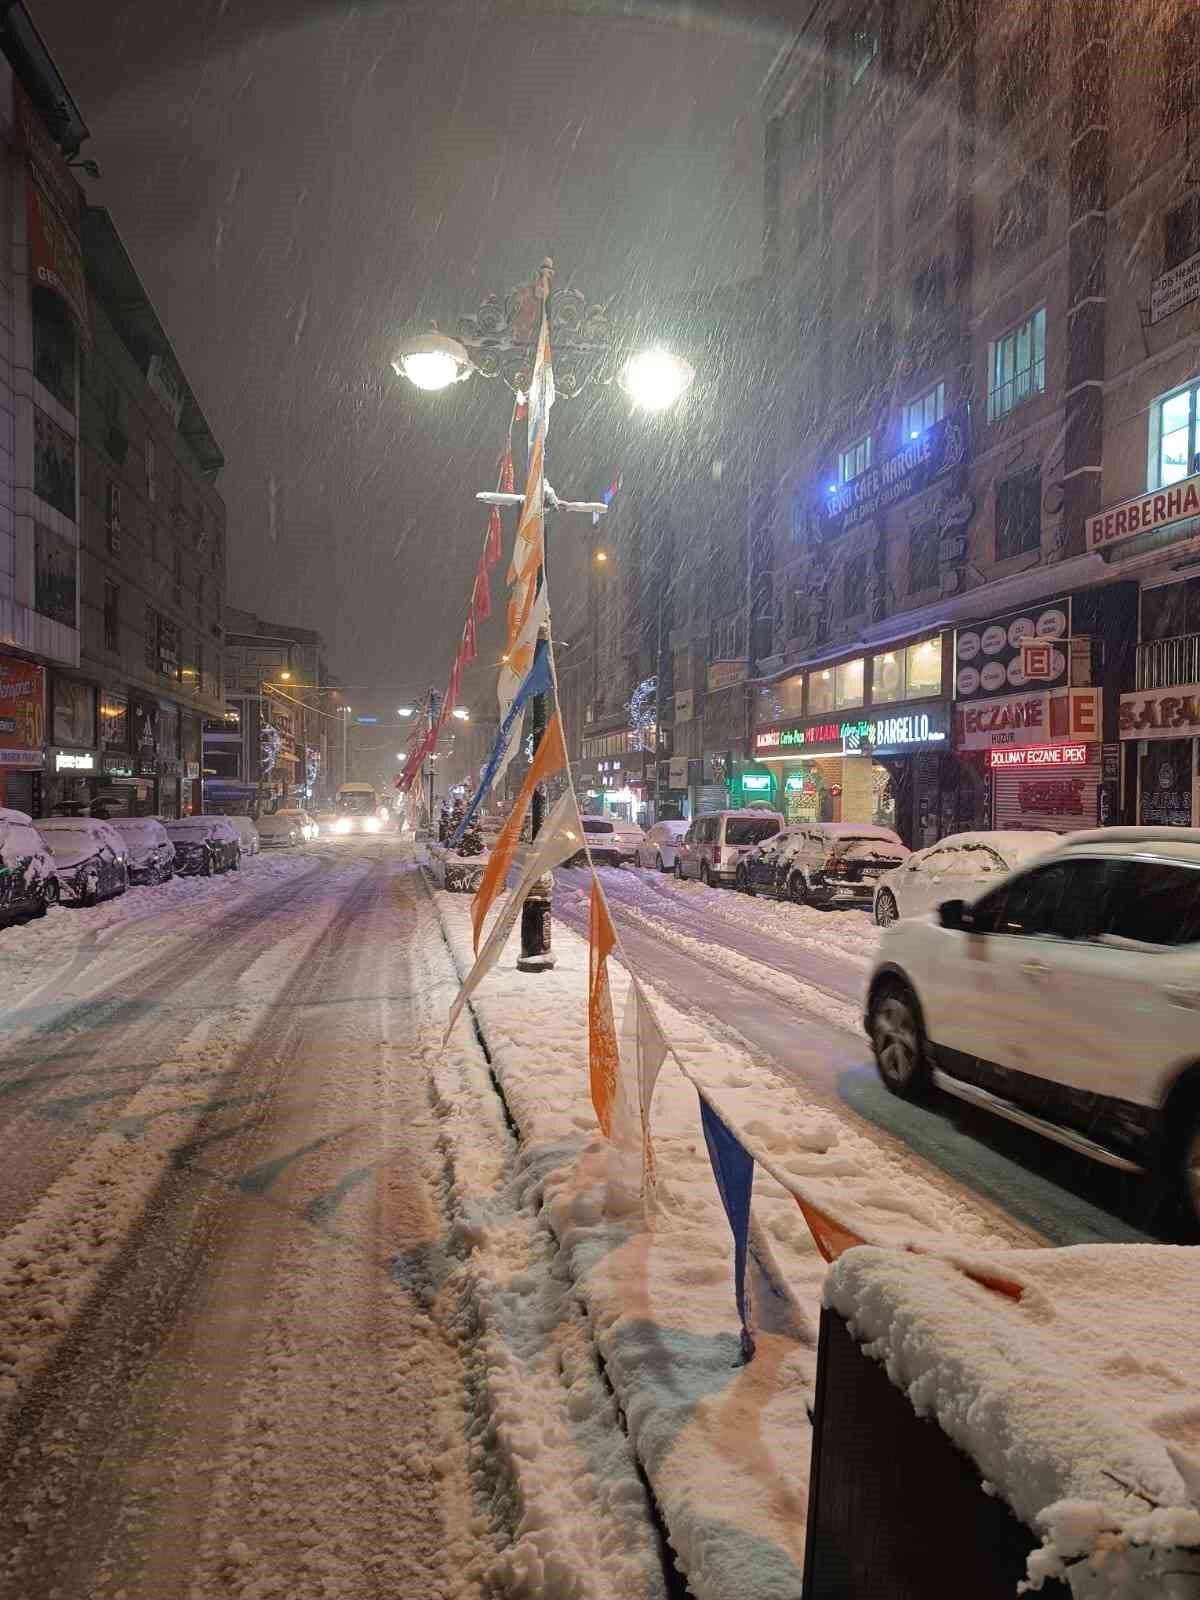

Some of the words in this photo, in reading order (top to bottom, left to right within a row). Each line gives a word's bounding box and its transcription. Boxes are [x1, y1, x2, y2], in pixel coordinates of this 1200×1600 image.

[855, 470, 880, 500] CAFE
[877, 714, 928, 745] BARGELLO
[966, 700, 1043, 733] ECZANE
[1073, 696, 1095, 733] E
[991, 751, 1026, 764] DOLUNAY
[1027, 749, 1061, 763] ECZANE
